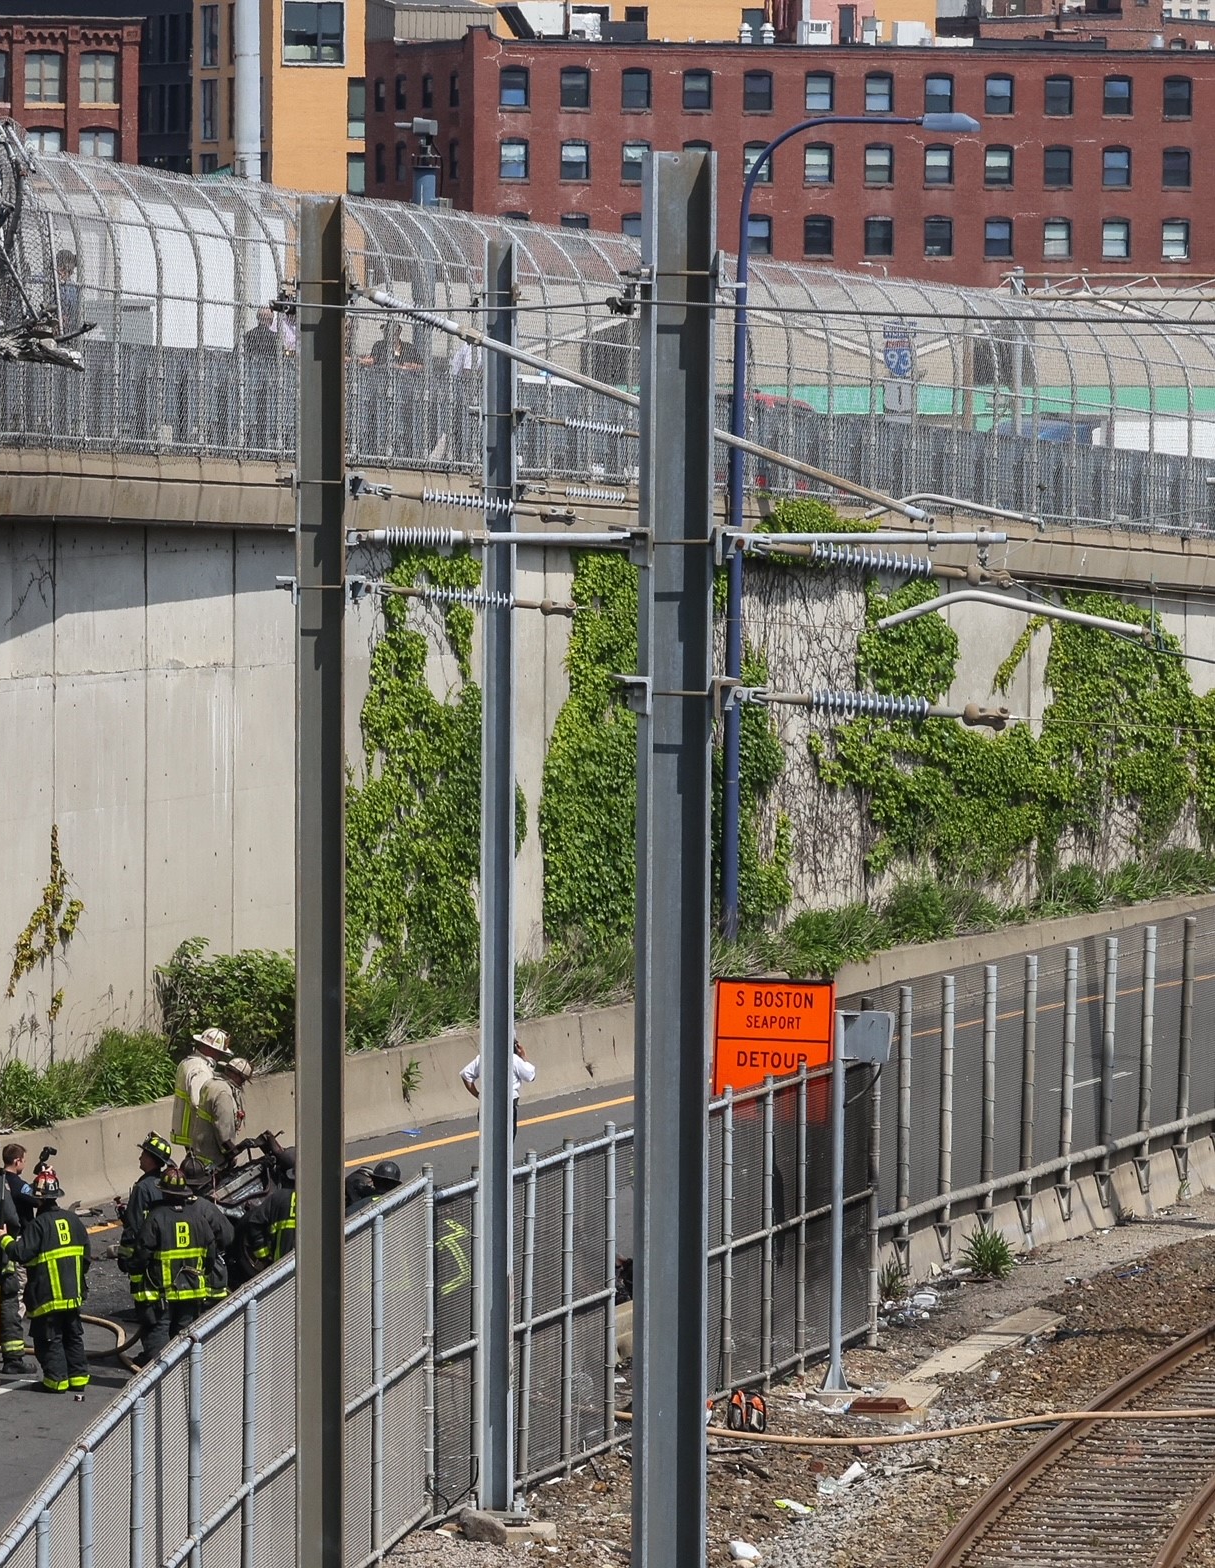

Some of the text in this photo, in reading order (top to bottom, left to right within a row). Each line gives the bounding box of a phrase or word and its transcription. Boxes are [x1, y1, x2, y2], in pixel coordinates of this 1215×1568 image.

[887, 350, 912, 369] 93
[736, 990, 814, 1009] S BOSTON
[746, 1015, 802, 1030] SEAPORT
[737, 1051, 808, 1069] DETOUR
